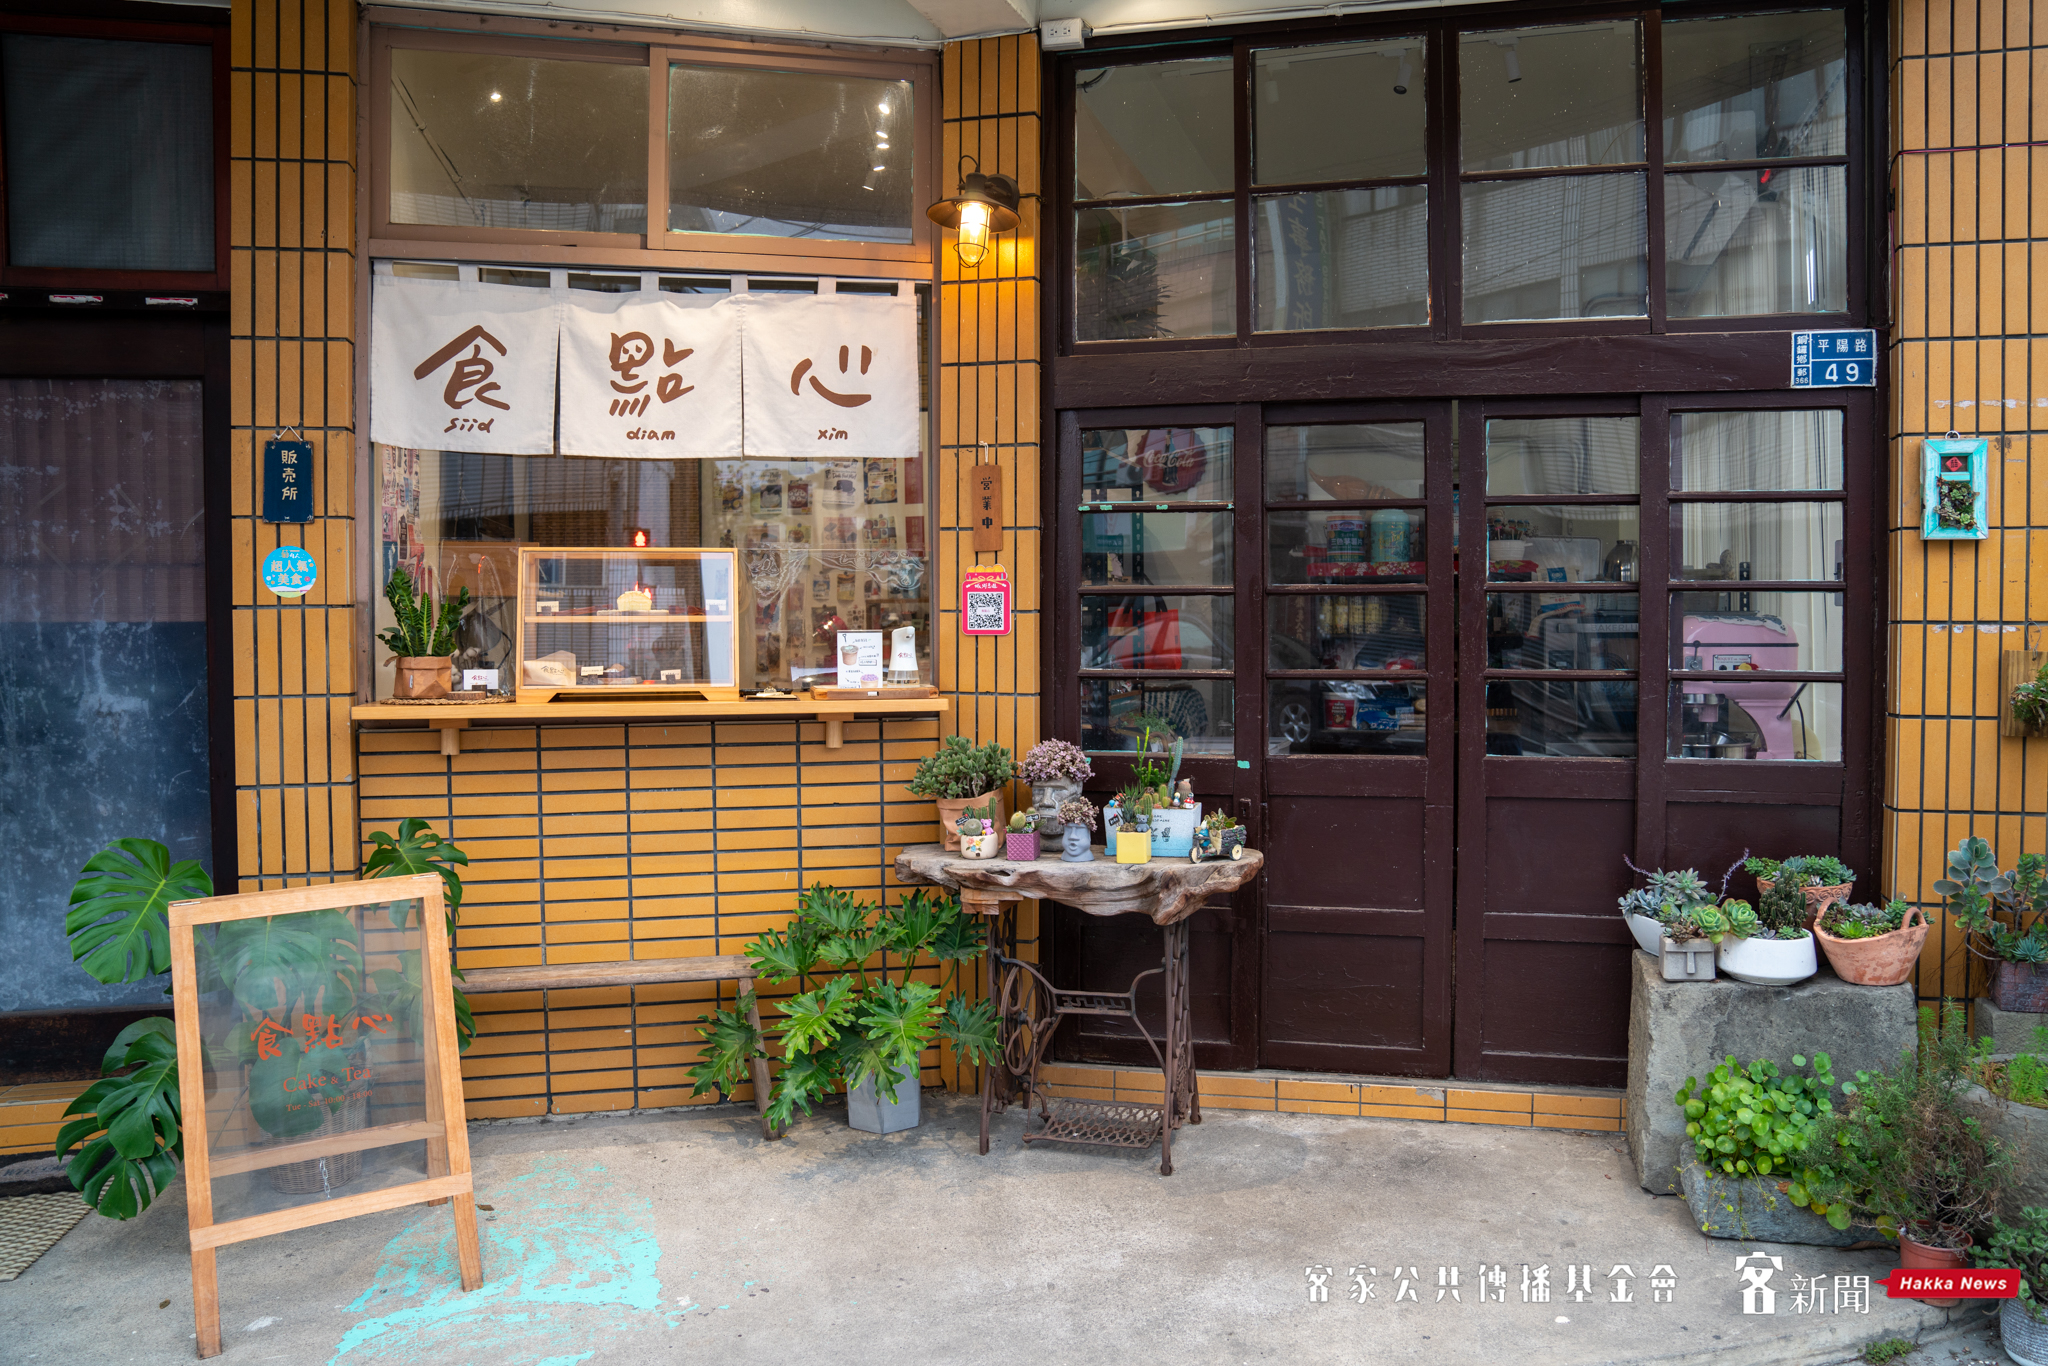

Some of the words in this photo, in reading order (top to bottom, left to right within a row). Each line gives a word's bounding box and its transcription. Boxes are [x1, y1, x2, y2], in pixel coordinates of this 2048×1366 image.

[1818, 338, 1867, 353] 平陽路
[1825, 363, 1859, 382] 49
[443, 417, 494, 433] siid
[626, 426, 676, 441] diam
[817, 427, 848, 440] xim
[281, 450, 298, 501] 販売所
[270, 560, 309, 572] 超人氣
[277, 573, 303, 585] 美食
[250, 1013, 394, 1061] 食點心
[283, 1073, 327, 1093] Cake
[330, 1076, 339, 1085] &
[341, 1066, 372, 1082] Tea
[286, 1103, 302, 1112] Tue
[308, 1100, 320, 1108] Sat
[325, 1095, 346, 1105] 10:00
[352, 1090, 373, 1100] 18:00
